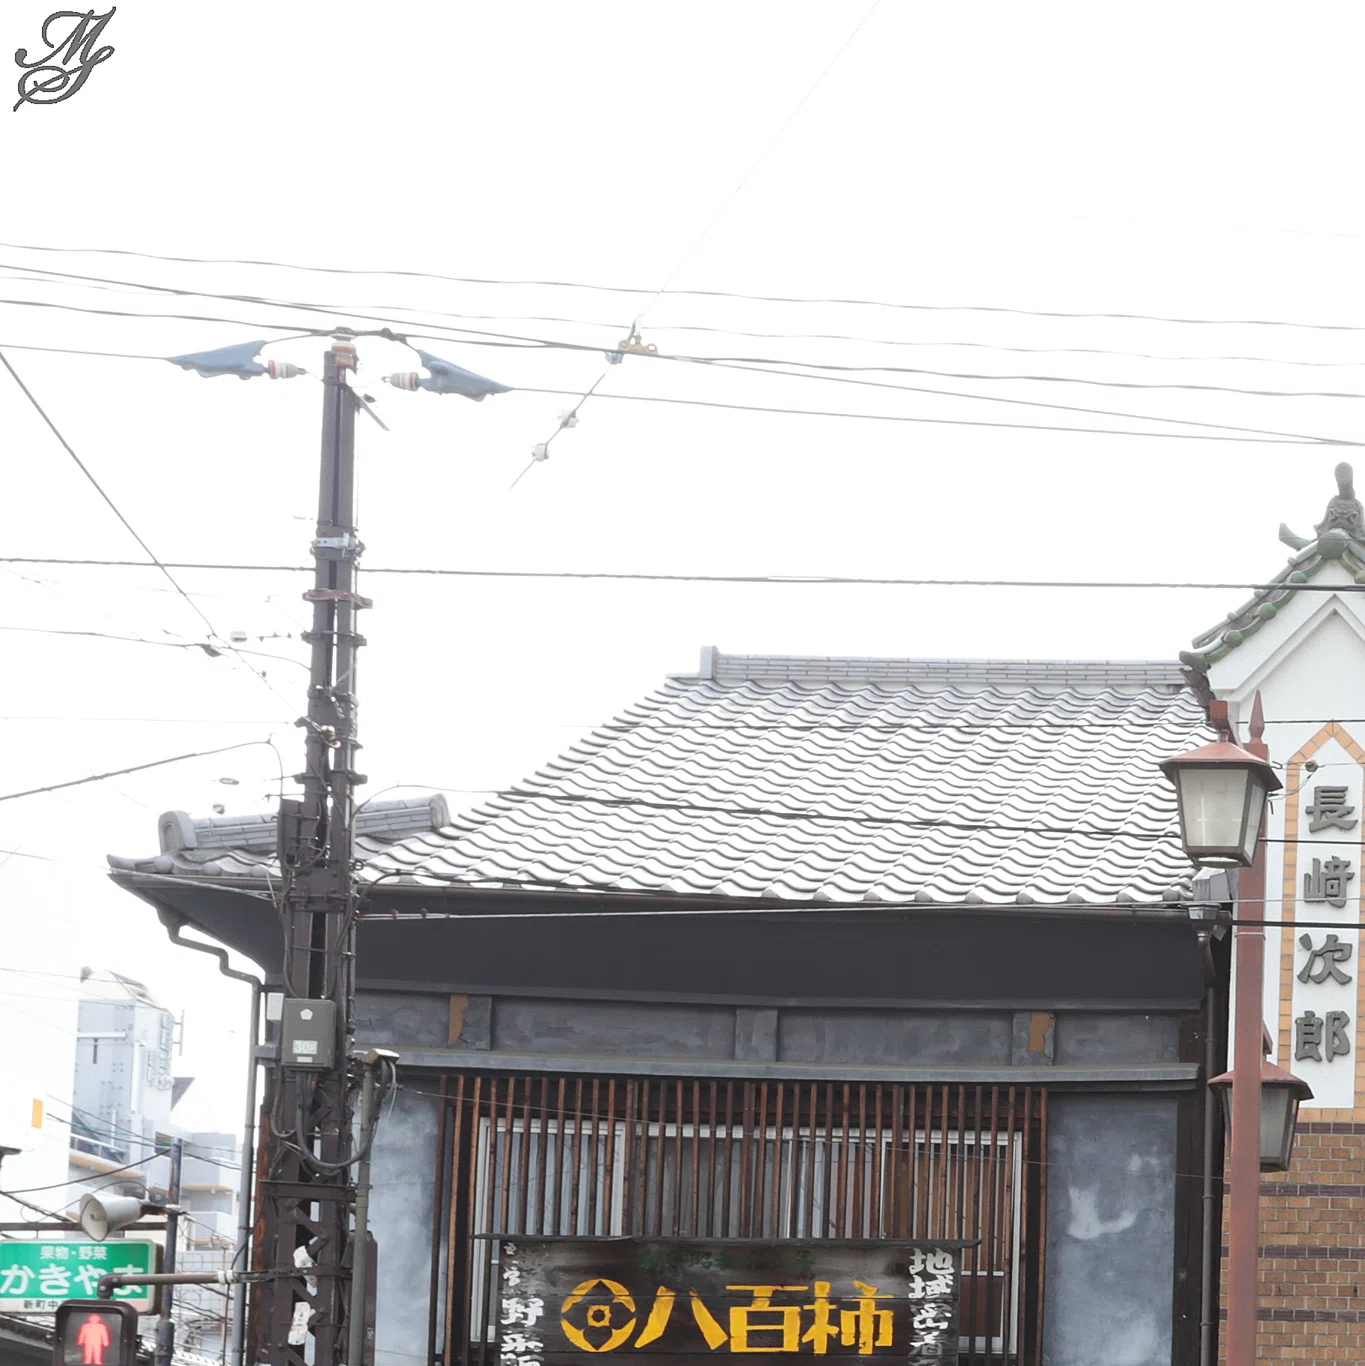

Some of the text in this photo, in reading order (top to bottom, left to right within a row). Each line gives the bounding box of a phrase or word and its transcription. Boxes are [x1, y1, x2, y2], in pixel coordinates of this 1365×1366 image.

[40, 1246, 108, 1260] 果物・野菜
[634, 1280, 894, 1355] 八百柿
